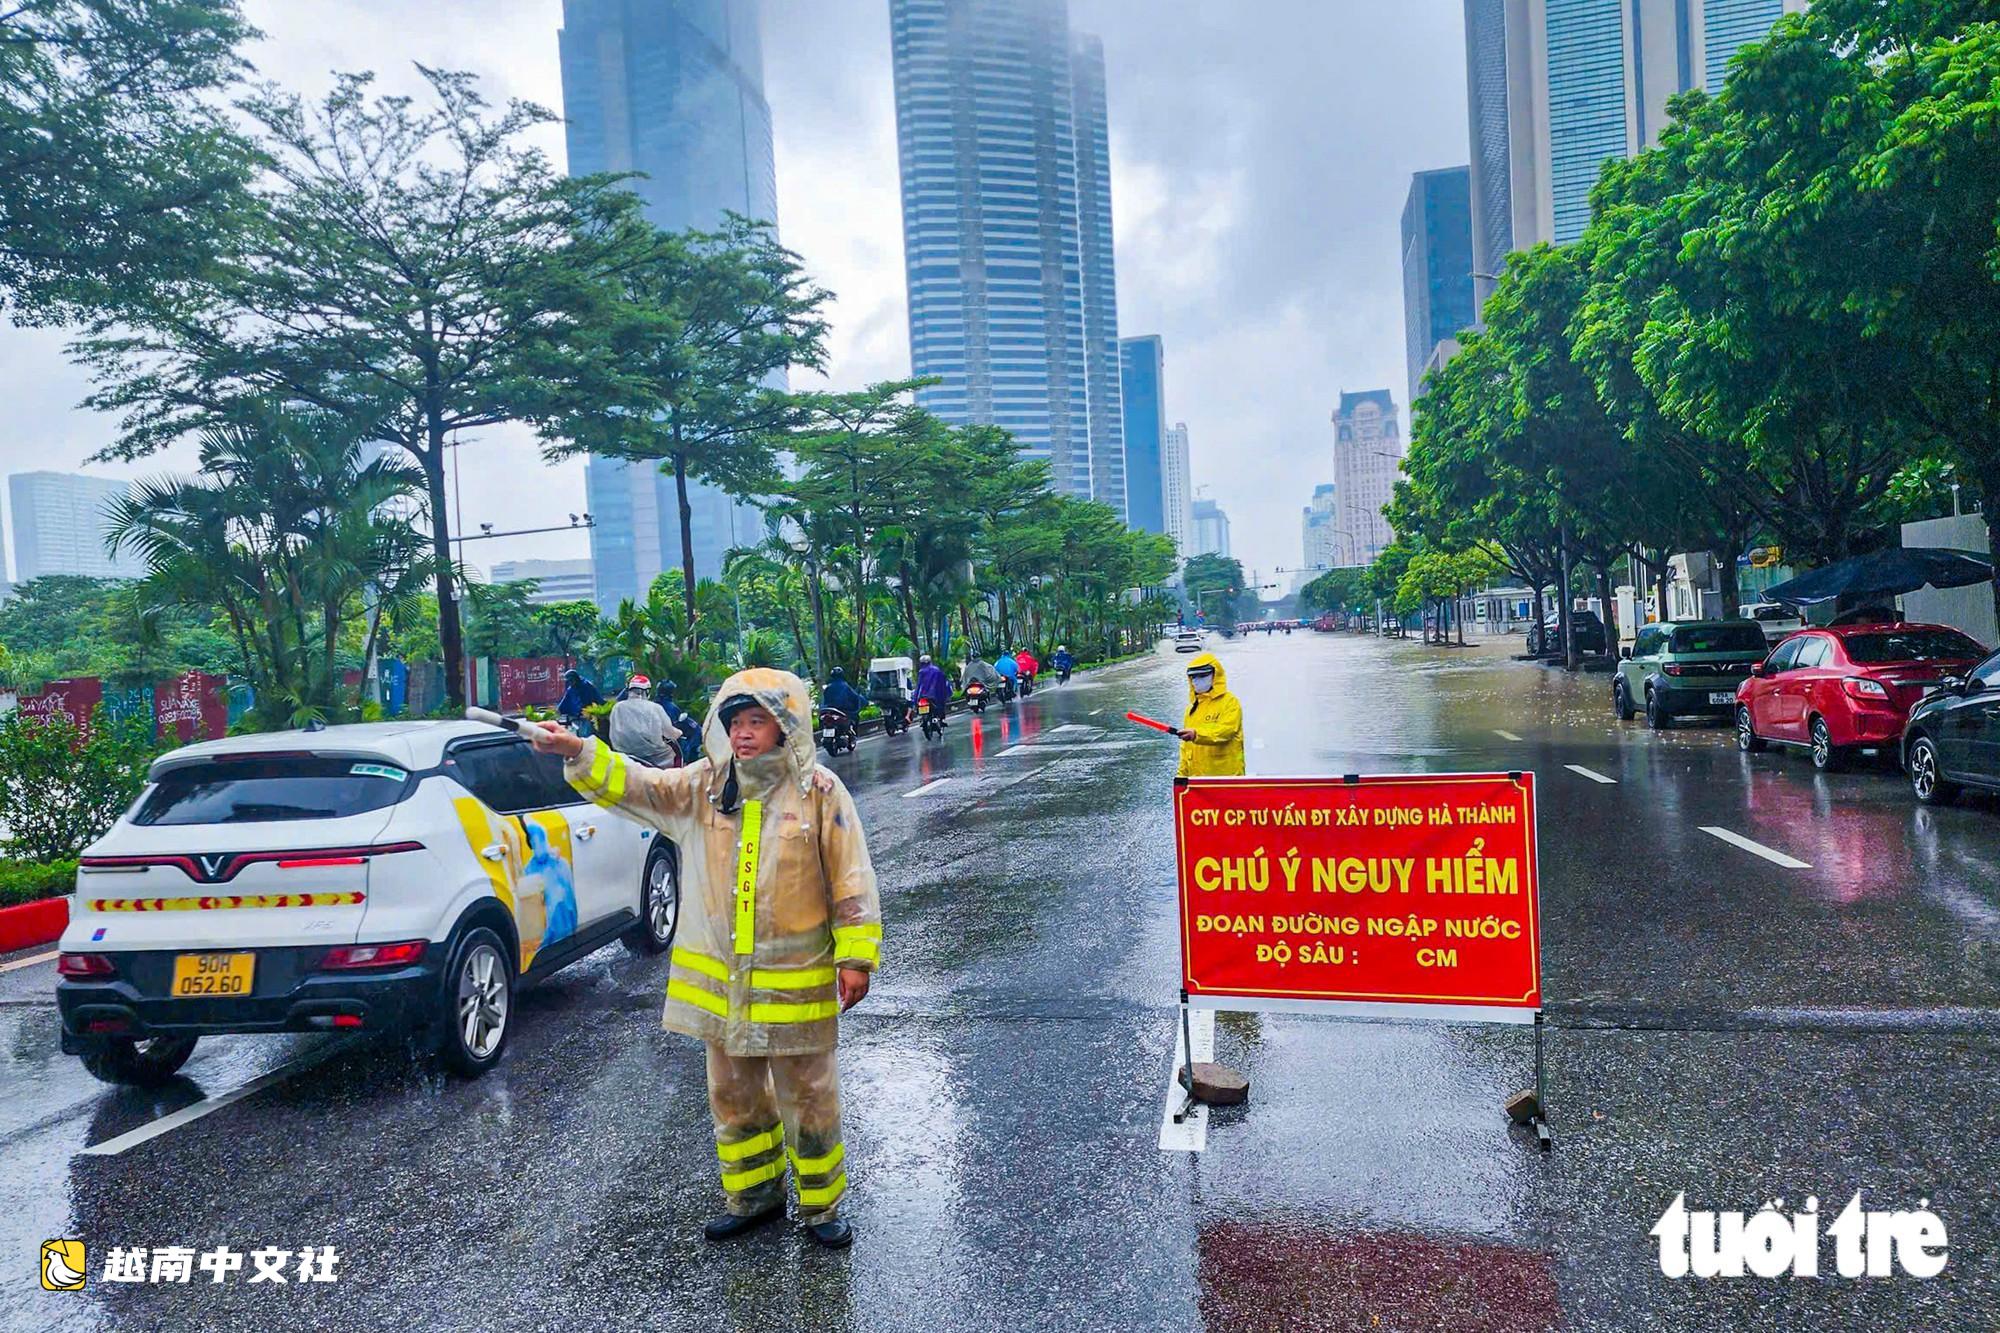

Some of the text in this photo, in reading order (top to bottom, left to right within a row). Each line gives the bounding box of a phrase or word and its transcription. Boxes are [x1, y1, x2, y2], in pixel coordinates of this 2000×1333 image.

[1190, 801, 1516, 831] CTY CP TƯ VẤN ĐT XÂY DỰNG HÀ THÀNH
[743, 841, 754, 913] CSGT
[1194, 837, 1519, 894] CHÚ Ý NGUY HIỂM
[1195, 911, 1521, 942] ĐOẠN ĐƯỜNG NGẬP NƯỚC
[197, 955, 231, 974] 90H
[1255, 940, 1292, 968] ĐỘ
[1298, 940, 1345, 965] SÂU
[1416, 948, 1459, 967] CM
[180, 975, 243, 995] 052.60
